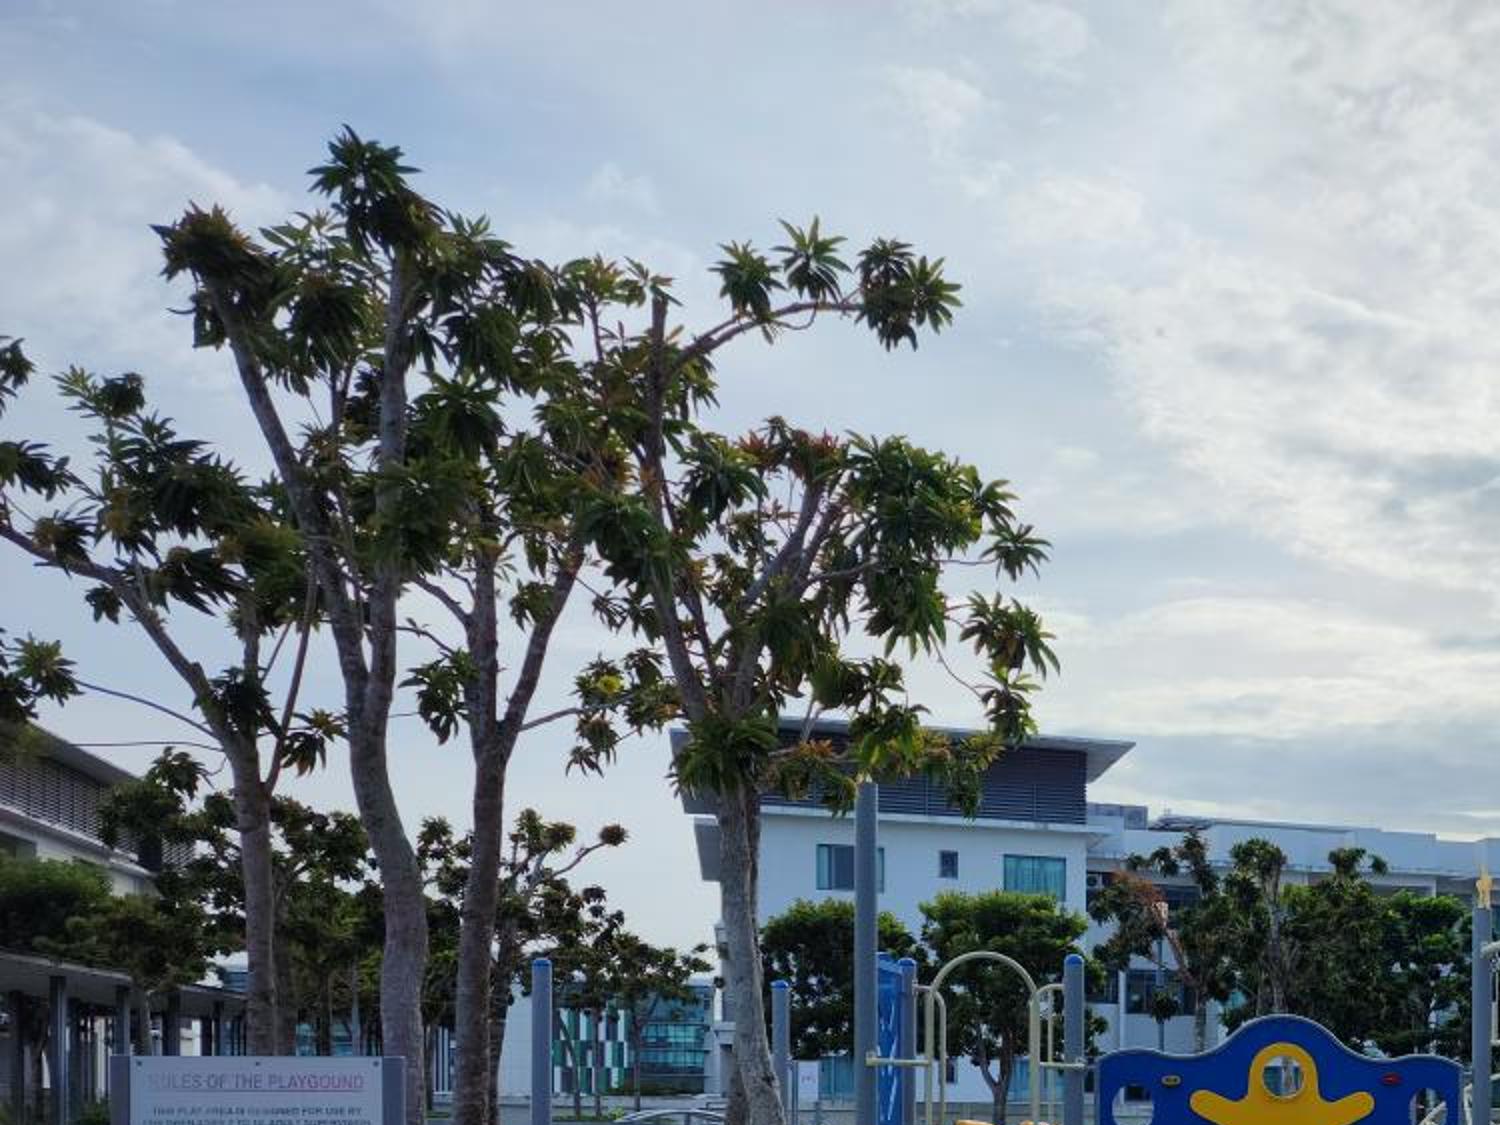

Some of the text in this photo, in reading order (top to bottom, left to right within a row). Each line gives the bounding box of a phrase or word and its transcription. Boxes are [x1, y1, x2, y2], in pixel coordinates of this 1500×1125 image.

[147, 1072, 364, 1089] RULES OF THE PLAYGOUND
